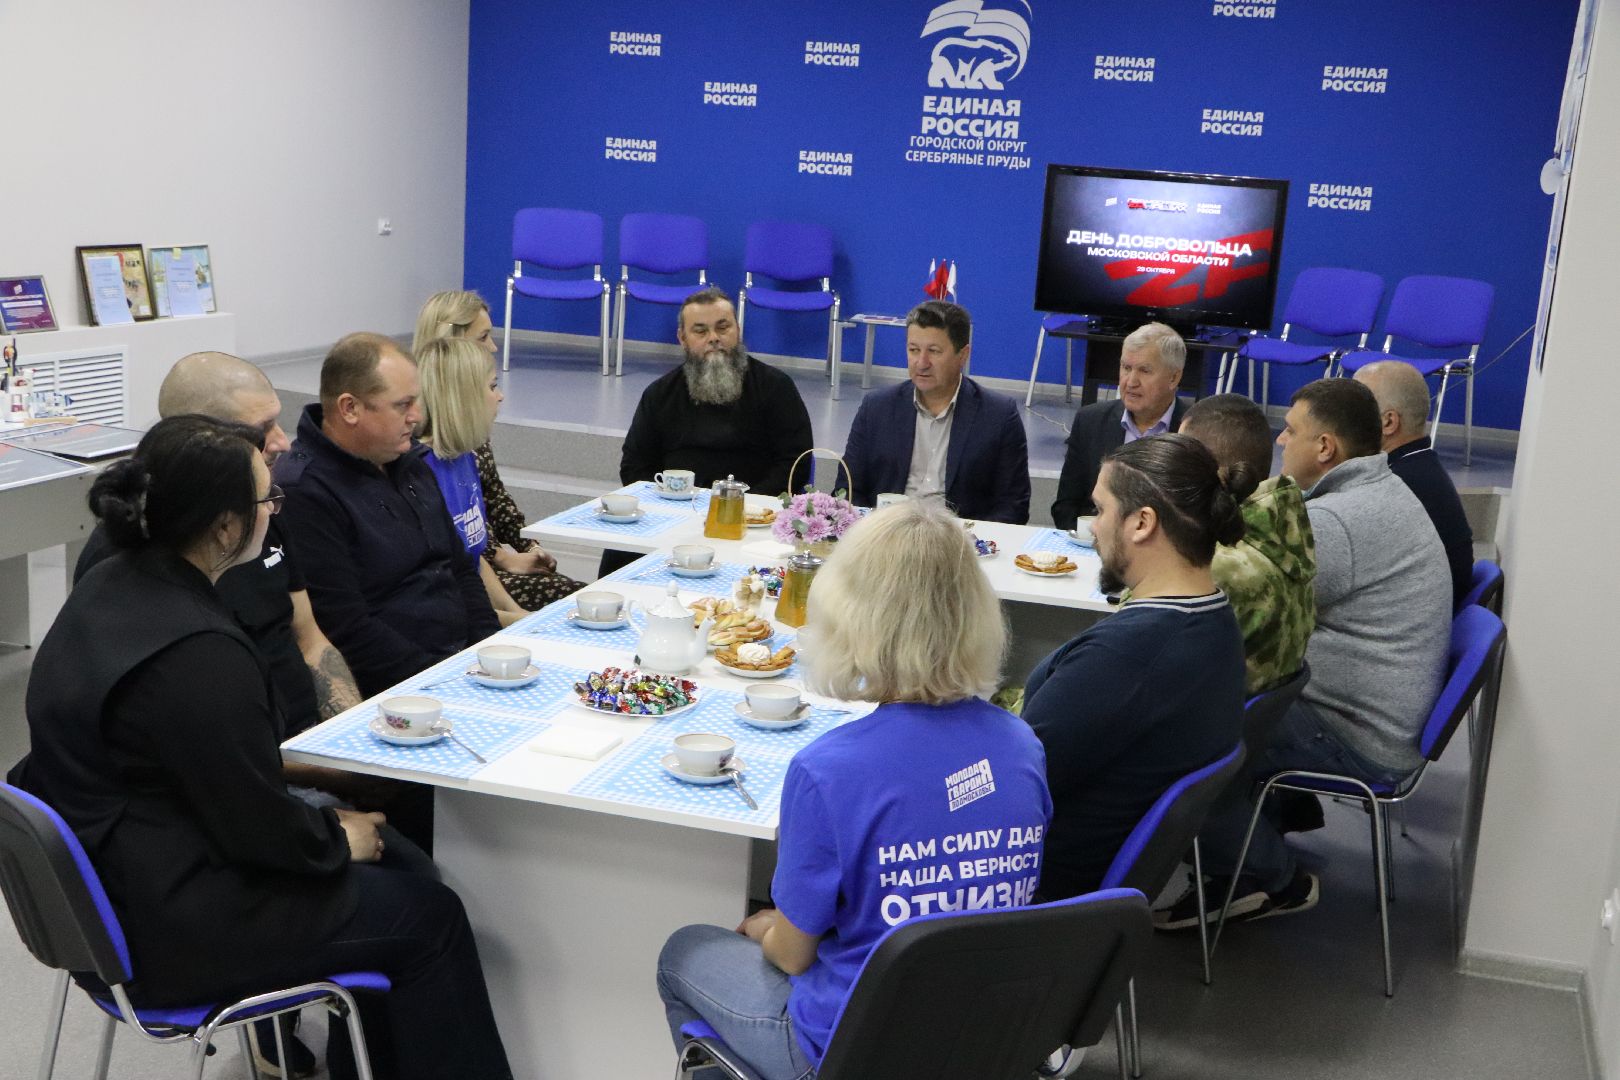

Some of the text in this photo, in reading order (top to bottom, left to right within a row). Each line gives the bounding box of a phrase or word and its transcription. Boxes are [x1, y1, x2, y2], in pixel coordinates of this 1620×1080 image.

[1213, 5, 1276, 19] РОССИЯ
[610, 31, 662, 44] ЕДИНАЯ
[609, 43, 661, 57] РОССИЯ
[805, 41, 861, 54] ЕДИНАЯ
[804, 53, 860, 67] РОССИЯ
[1095, 55, 1156, 69] ЕДИНАЯ
[1093, 68, 1154, 82] РОССИЯ
[1323, 66, 1389, 80] ЕДИНАЯ
[704, 81, 758, 94] ЕДИНАЯ
[1321, 79, 1387, 93] РОССИЯ
[703, 93, 757, 107] РОССИЯ
[922, 95, 1022, 117] ЕДИНАЯ
[1202, 109, 1265, 123] ЕДИНАЯ
[921, 116, 1020, 139] РОССИЯ
[1201, 122, 1263, 136] РОССИЯ
[606, 137, 657, 150] ЕДИНАЯ
[909, 135, 1028, 153] ГОРОДСКОЙ ОКРУГ
[605, 149, 657, 163] РОССИЯ
[799, 150, 853, 164] ЕДИНАЯ
[905, 150, 1031, 170] СЕРЕБРЯНЫЕ ПРУДЫ
[798, 162, 853, 177] РОССИЯ
[1309, 184, 1373, 198] ЕДИНАЯ
[1307, 196, 1372, 211] РОССИЯ
[1066, 230, 1252, 258] ДЕНЬ ДОБРОВОЛЬЦА
[1087, 247, 1229, 267] МОСКОВСКОЙ ОБЛАСТИ
[878, 838, 936, 865] НАМ
[942, 828, 1003, 855] СИЛУ
[880, 864, 954, 888] НАША
[880, 876, 1038, 927] ОТЧИЗНЕ
